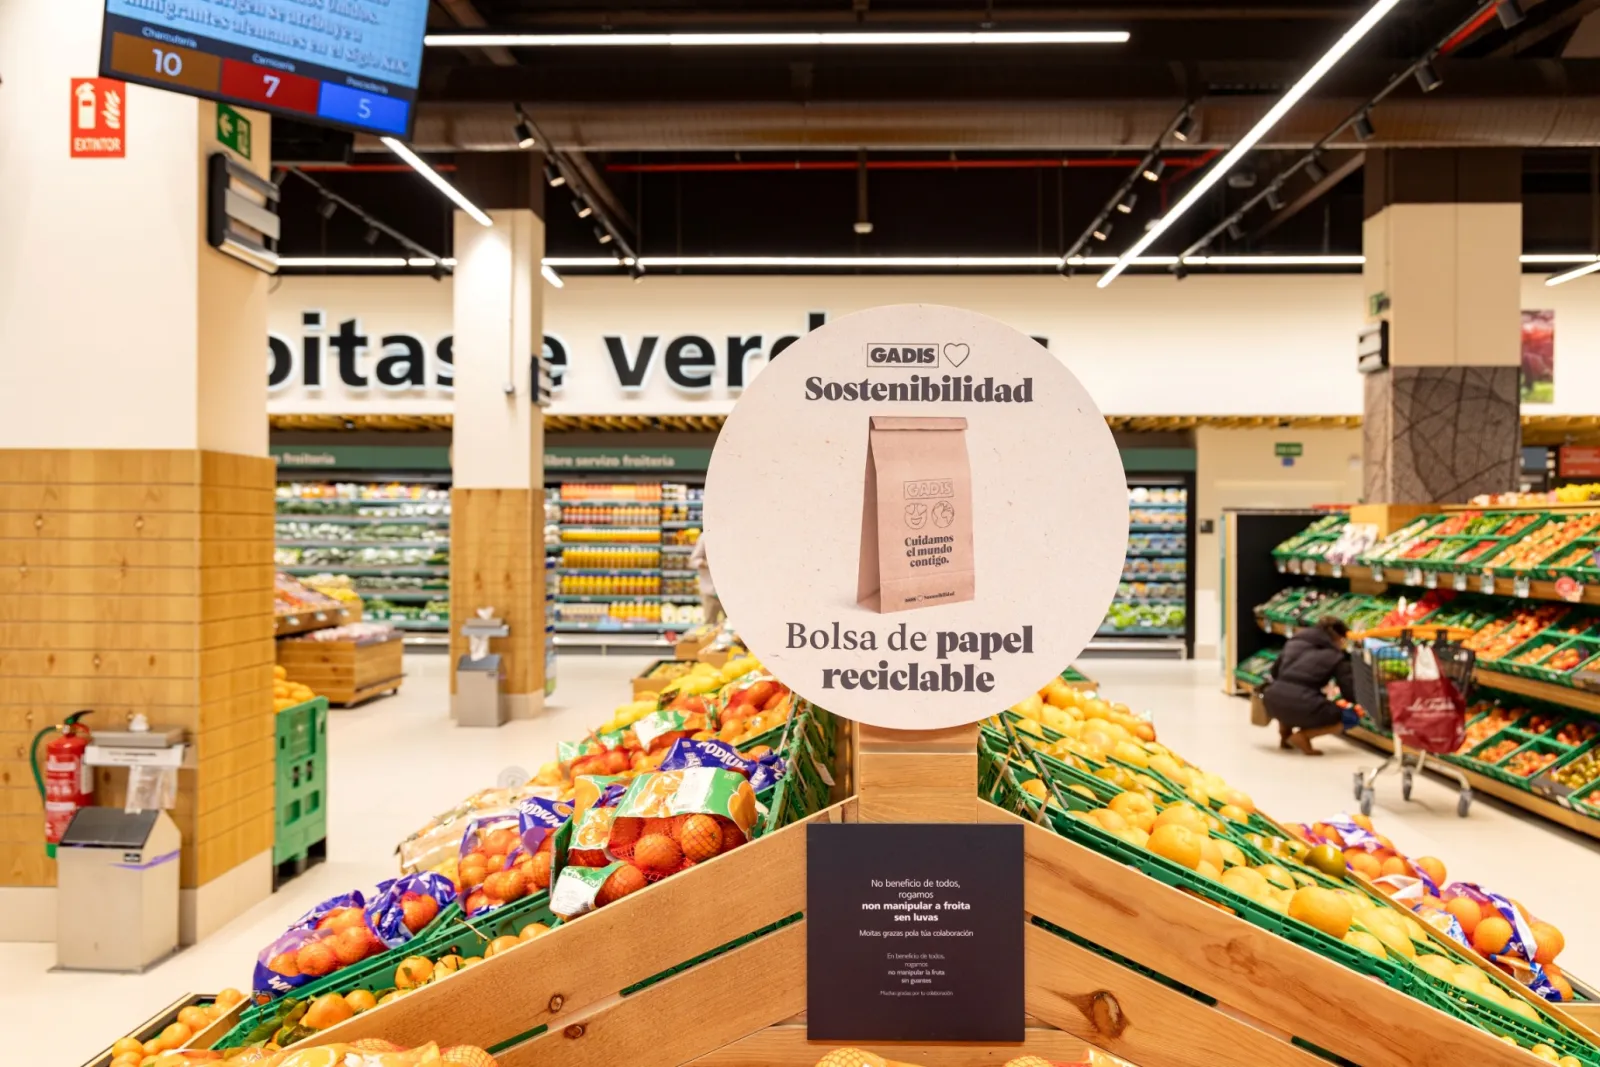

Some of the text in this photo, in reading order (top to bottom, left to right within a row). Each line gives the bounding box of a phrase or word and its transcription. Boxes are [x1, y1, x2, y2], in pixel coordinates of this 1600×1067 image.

[152, 48, 183, 77] 10
[263, 74, 280, 98] 7
[357, 98, 371, 119] 5
[74, 137, 121, 152] EXTINTOR
[870, 347, 936, 365] GADIS
[805, 375, 1033, 403] Sostenibilidad
[906, 482, 952, 497] GADIS
[904, 534, 954, 547] Cuidamos
[906, 544, 952, 557] el mundo
[909, 555, 950, 568] contigo.
[785, 622, 1034, 660] Bolsa de papel
[821, 660, 995, 693] reciclable
[871, 879, 961, 889] No beneficio de todos,
[898, 891, 934, 901] rogamos
[862, 901, 971, 912] non manipular a froita
[894, 913, 939, 922] sen luvas
[859, 929, 974, 939] Moitas grazas pola túa colaboración
[896, 969, 925, 977] manipular
